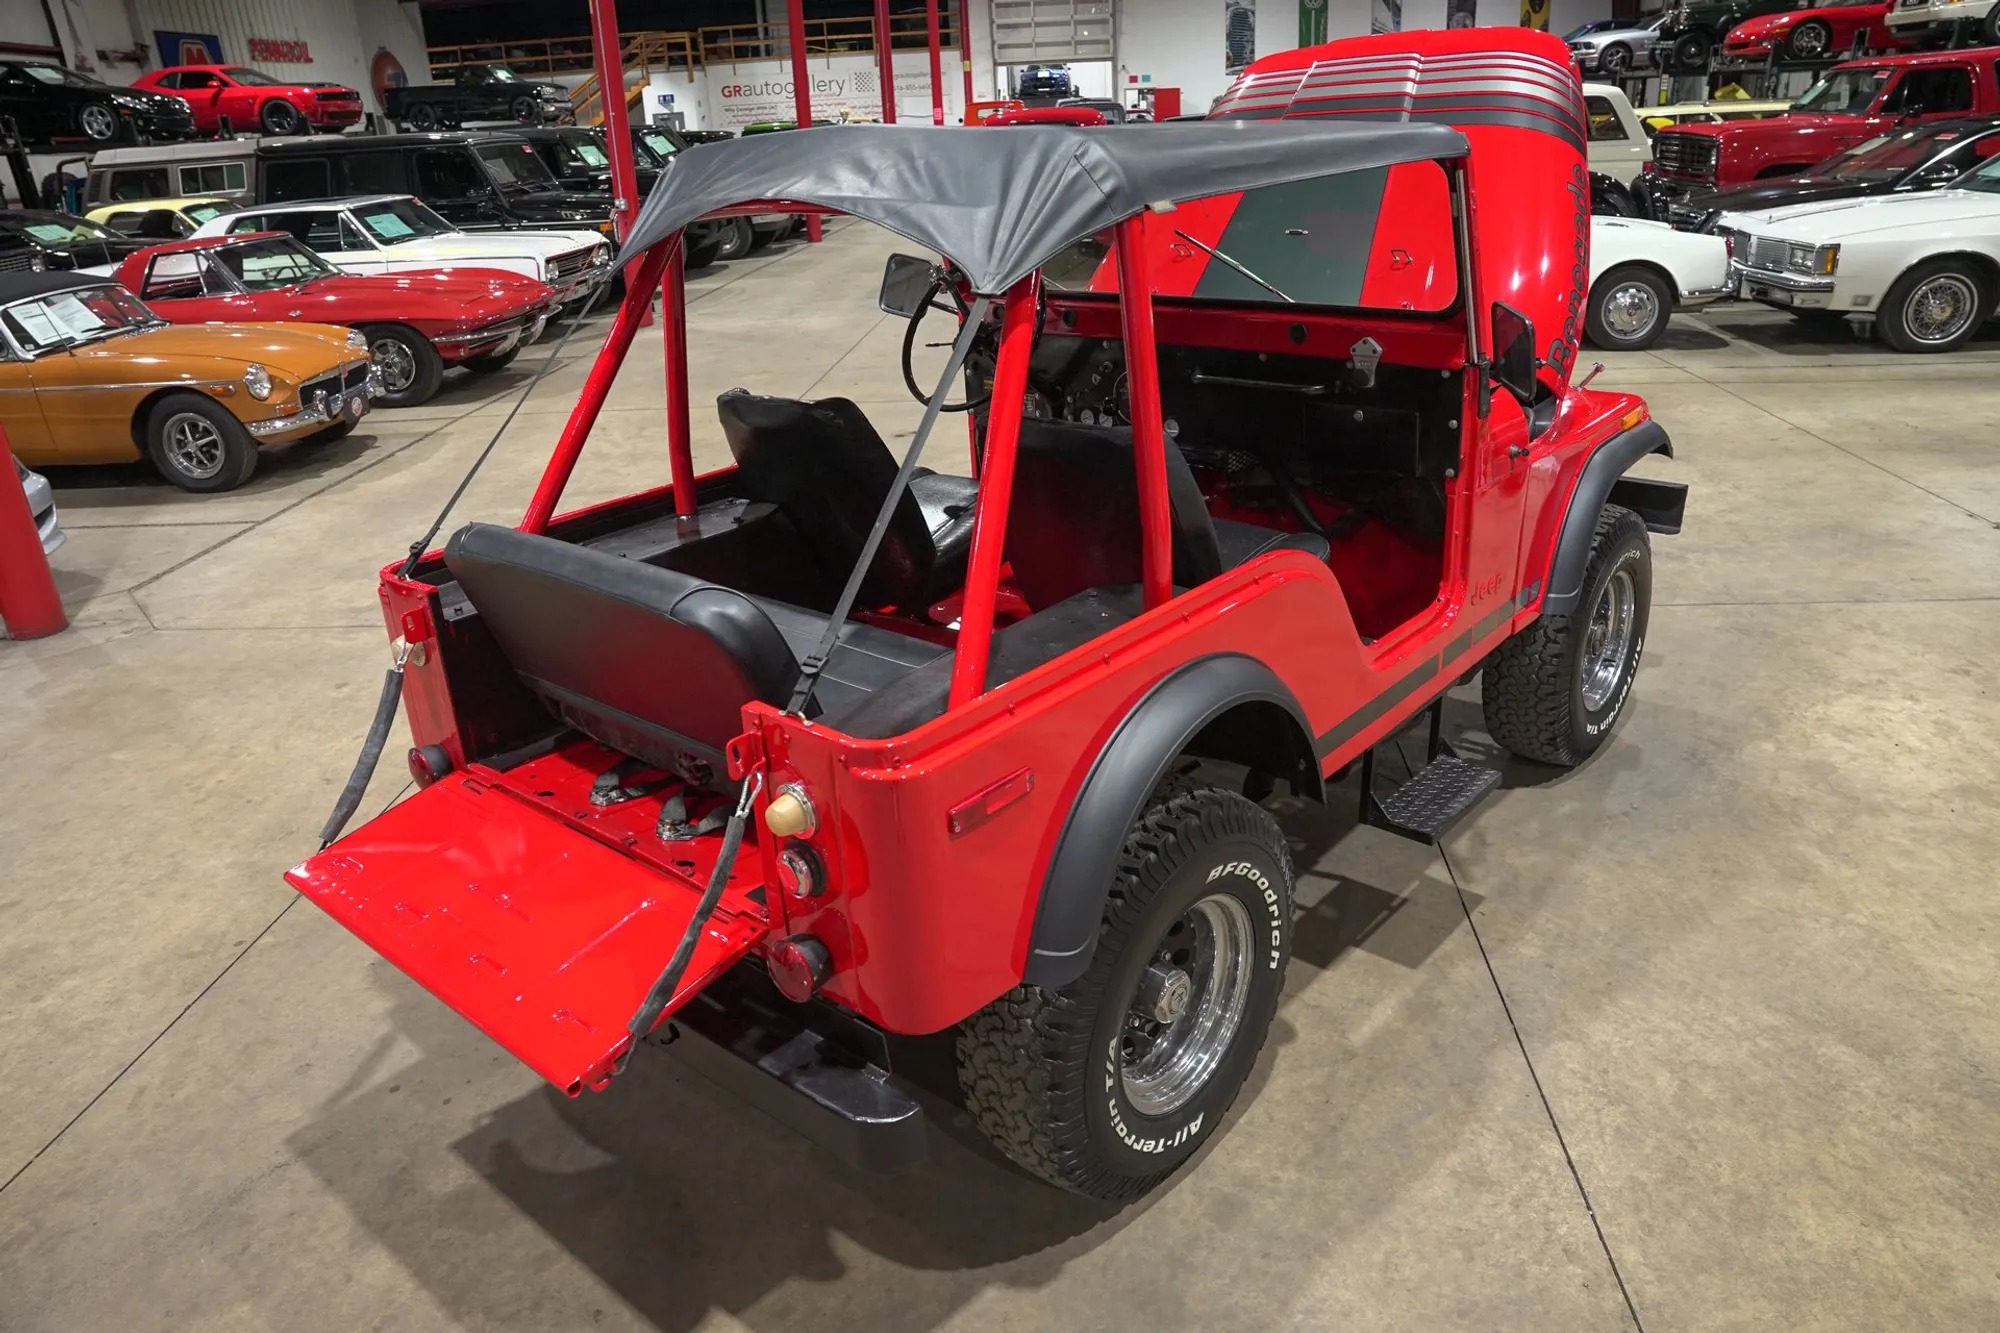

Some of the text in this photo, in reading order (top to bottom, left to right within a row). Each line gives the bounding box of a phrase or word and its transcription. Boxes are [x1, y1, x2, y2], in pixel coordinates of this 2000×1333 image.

[721, 74, 846, 99] GRautoglery
[1547, 163, 1589, 376] Renegade
[1600, 636, 1642, 731] All-Terrain
[1205, 861, 1282, 970] BFGoodrich
[1108, 1097, 1205, 1154] All-Terrain
